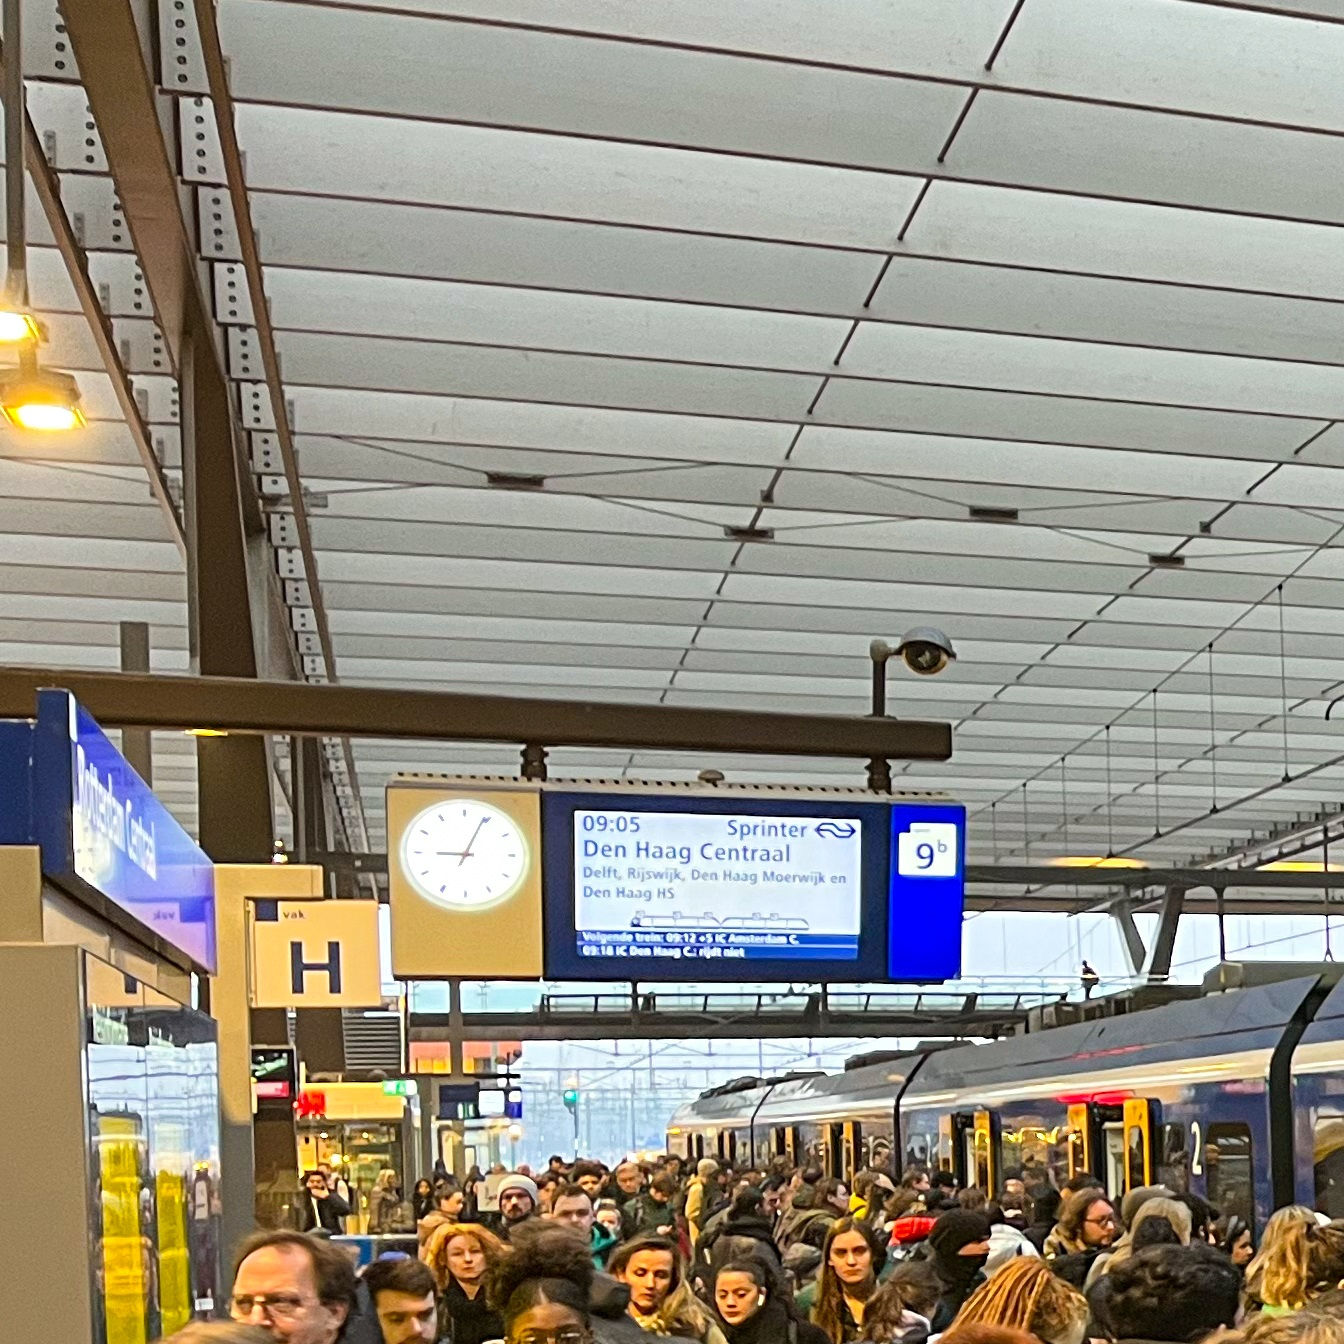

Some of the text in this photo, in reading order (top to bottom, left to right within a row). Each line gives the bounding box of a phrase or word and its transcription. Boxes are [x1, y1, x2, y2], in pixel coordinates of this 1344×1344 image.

[583, 815, 640, 833] 09:05
[727, 819, 808, 841] Sprinter
[583, 839, 791, 865] Den Haag Centraal
[583, 866, 847, 886] Delft, Rijswijk, Den Haag Moerwijk en
[583, 886, 675, 902] Den Haag HS
[282, 909, 305, 919] vak
[582, 931, 634, 944] Volgende
[728, 933, 788, 945] Amsterdam
[290, 941, 341, 994] H
[1191, 1121, 1203, 1175] 2
